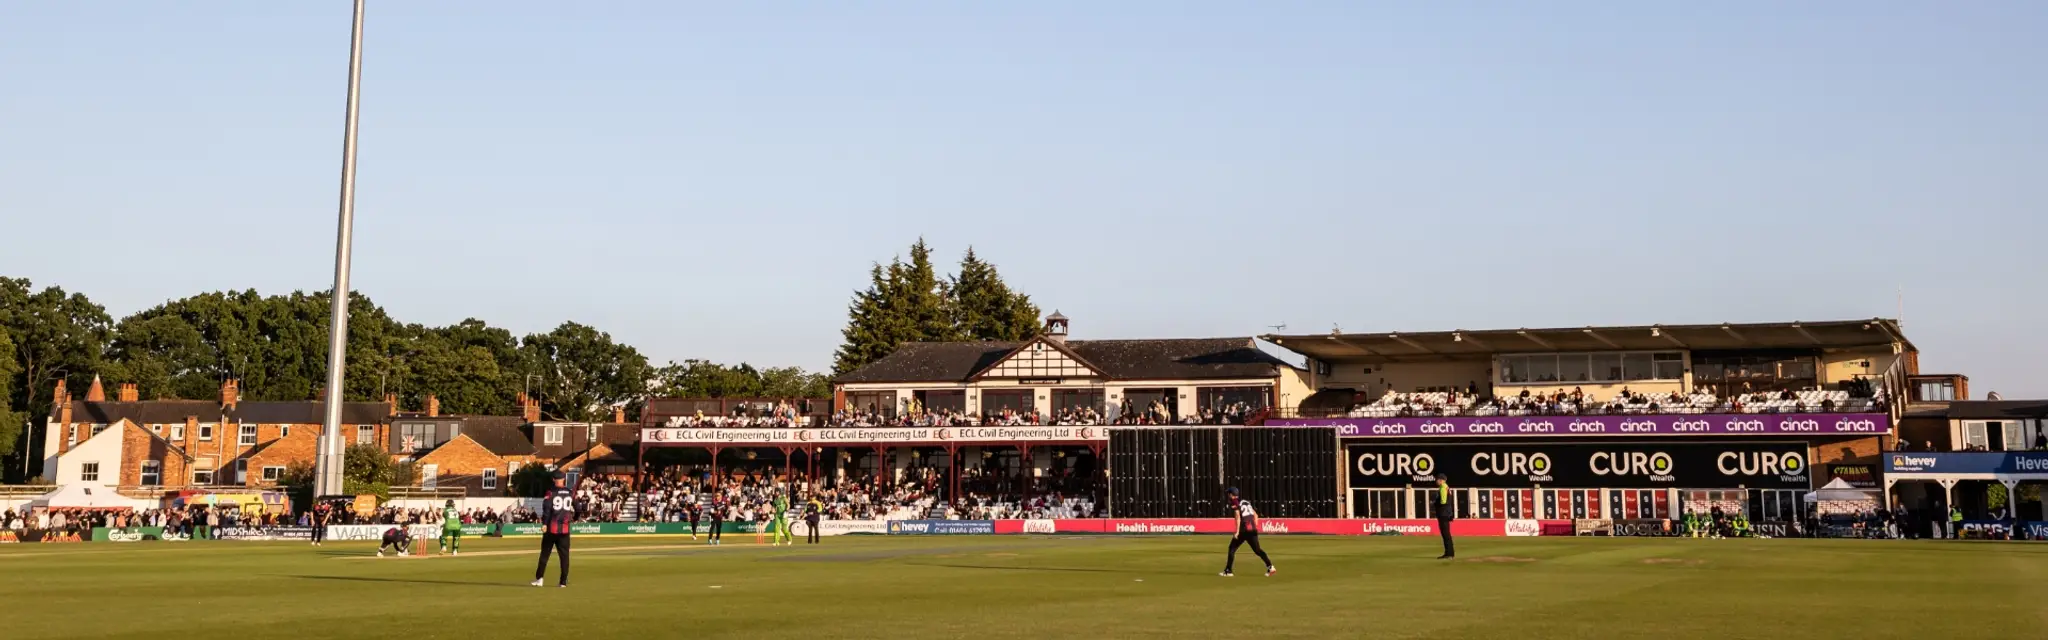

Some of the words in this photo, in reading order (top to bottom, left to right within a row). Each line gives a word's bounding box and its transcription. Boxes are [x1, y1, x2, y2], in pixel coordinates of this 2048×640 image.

[1373, 421, 1406, 434] cinch
[1420, 420, 1454, 433] cinch
[1469, 420, 1504, 433] cinch
[1519, 419, 1554, 432] cinch
[1569, 418, 1605, 432] cinch
[1620, 418, 1656, 432] cinch
[1672, 417, 1709, 432] cinch
[1726, 417, 1764, 432] cinch
[1780, 417, 1818, 432] cinch
[1835, 417, 1875, 432] cinch
[676, 430, 693, 440] ECL
[695, 430, 714, 439] Civil
[716, 430, 771, 441] Engineering
[773, 429, 787, 440] Ltd
[820, 430, 836, 439] ECL
[838, 430, 856, 440] Civil
[858, 429, 910, 441] Engineering
[913, 429, 927, 439] Ltd
[959, 429, 976, 438] ECL
[978, 429, 996, 438] Civil
[999, 428, 1053, 440] Engineering
[1055, 428, 1069, 438] Ltd
[1357, 453, 1434, 476] CURO
[1471, 452, 1551, 476] CURO
[1589, 452, 1673, 476] CURO
[1717, 452, 1805, 476] CURO
[1905, 456, 1936, 468] hevey
[1529, 474, 1553, 482] Wealth
[553, 496, 572, 511] 90
[902, 522, 929, 532] hevey
[1116, 523, 1148, 533] Health
[1150, 523, 1195, 533] insurance
[1262, 520, 1288, 533] Vitality
[1363, 523, 1382, 532] Life
[1384, 523, 1431, 533] insurance
[1508, 520, 1536, 536] Vitality
